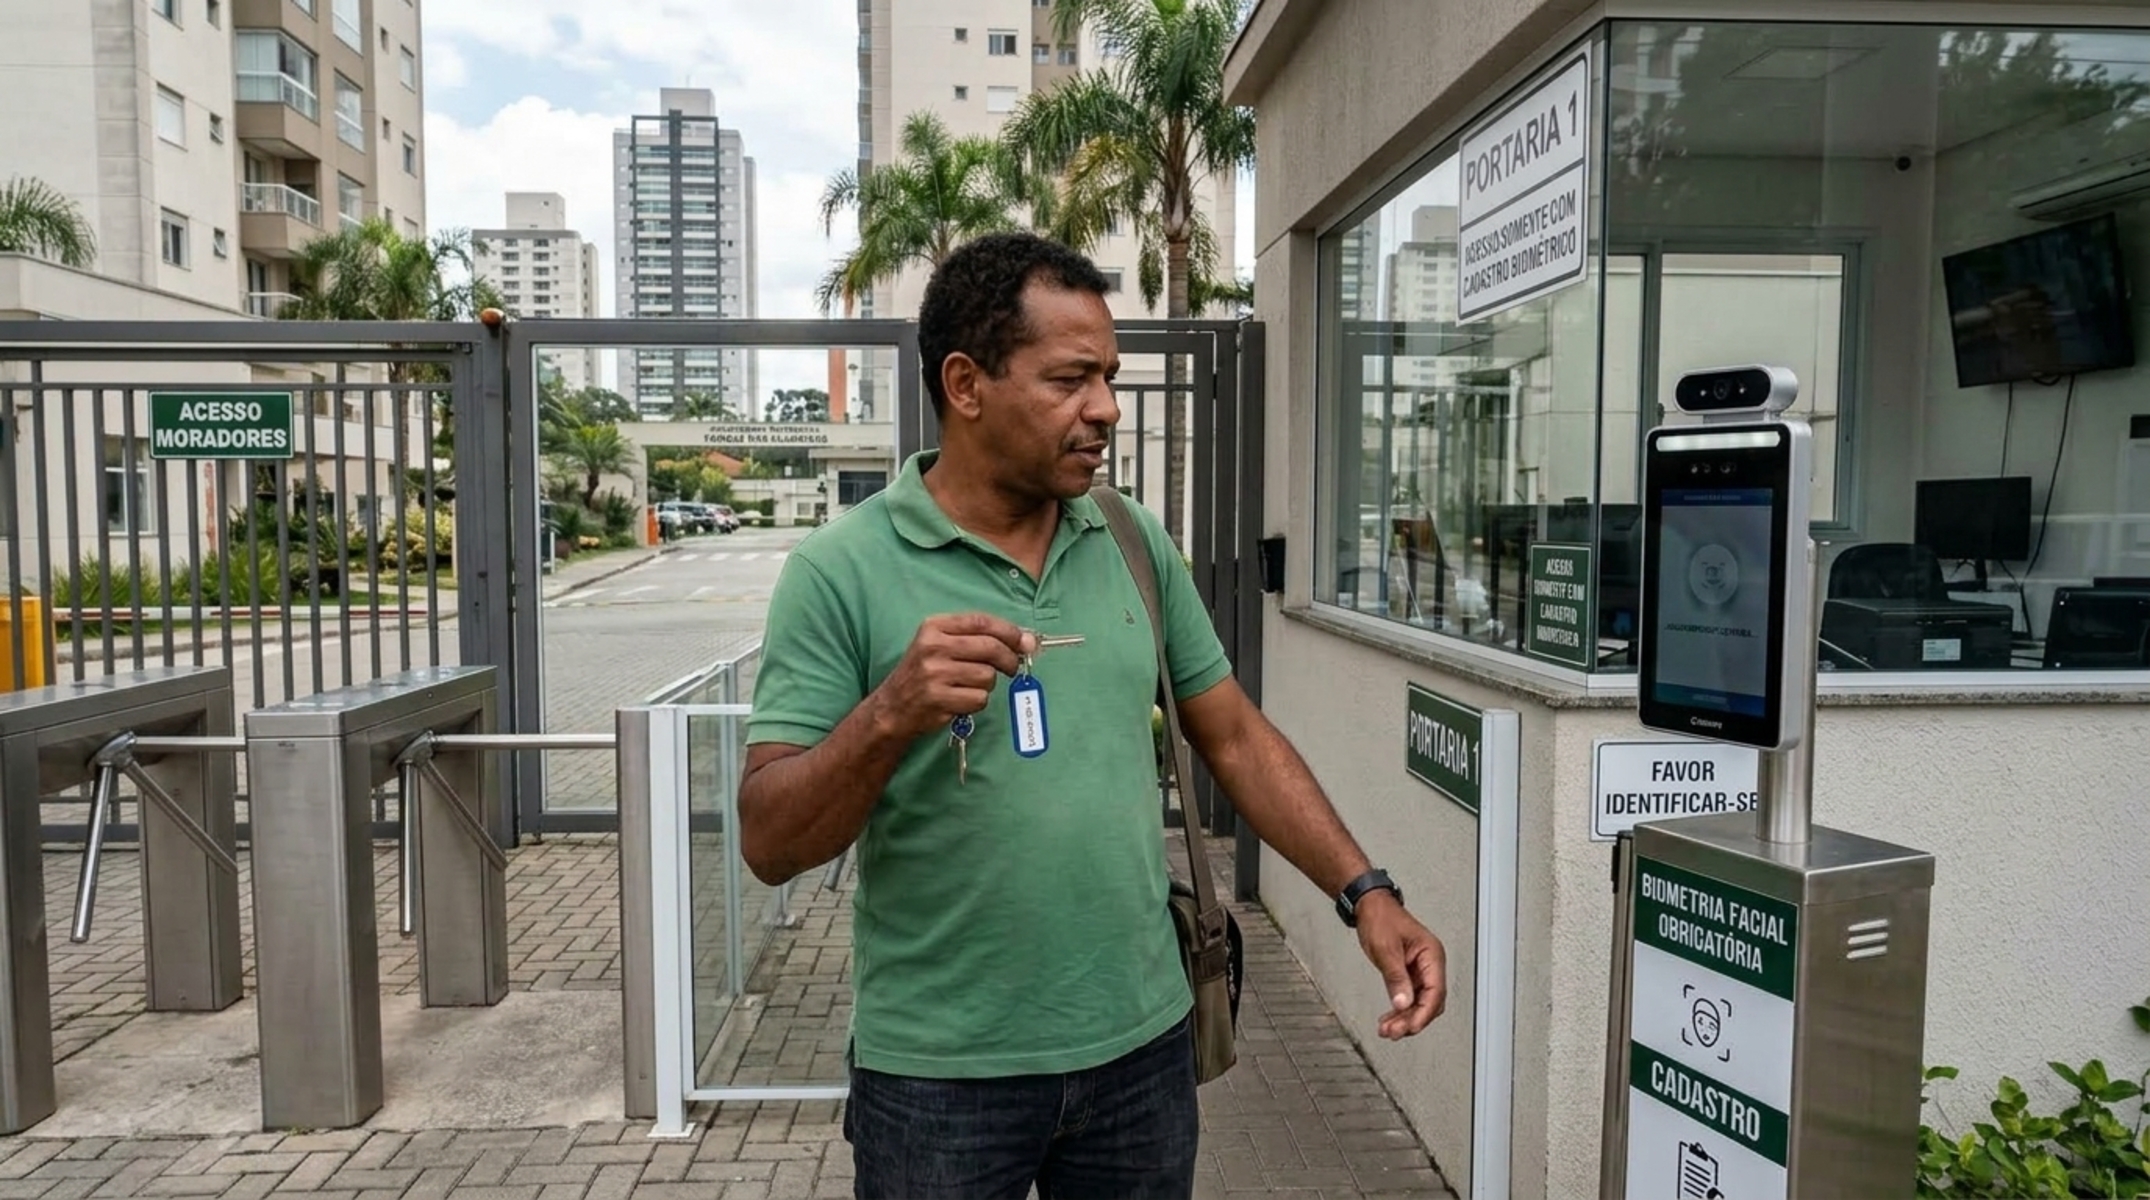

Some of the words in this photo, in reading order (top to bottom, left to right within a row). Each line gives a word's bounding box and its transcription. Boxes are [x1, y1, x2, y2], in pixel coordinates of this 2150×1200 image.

[1465, 104, 1562, 200] PORTARIA
[1568, 90, 1577, 137] 1
[1549, 188, 1576, 225] COM
[179, 402, 262, 421] ACESSO
[156, 429, 287, 448] MORADORES
[1410, 709, 1468, 781] PORTARIA
[1473, 741, 1479, 785] 1
[1652, 761, 1715, 782] FAVOR
[1606, 792, 1758, 814] IDENTIFICAR-SE
[1642, 872, 1725, 924] BIOMETRIA
[1729, 901, 1788, 946] FACIAL
[1651, 1060, 1760, 1142] CADASTRO
